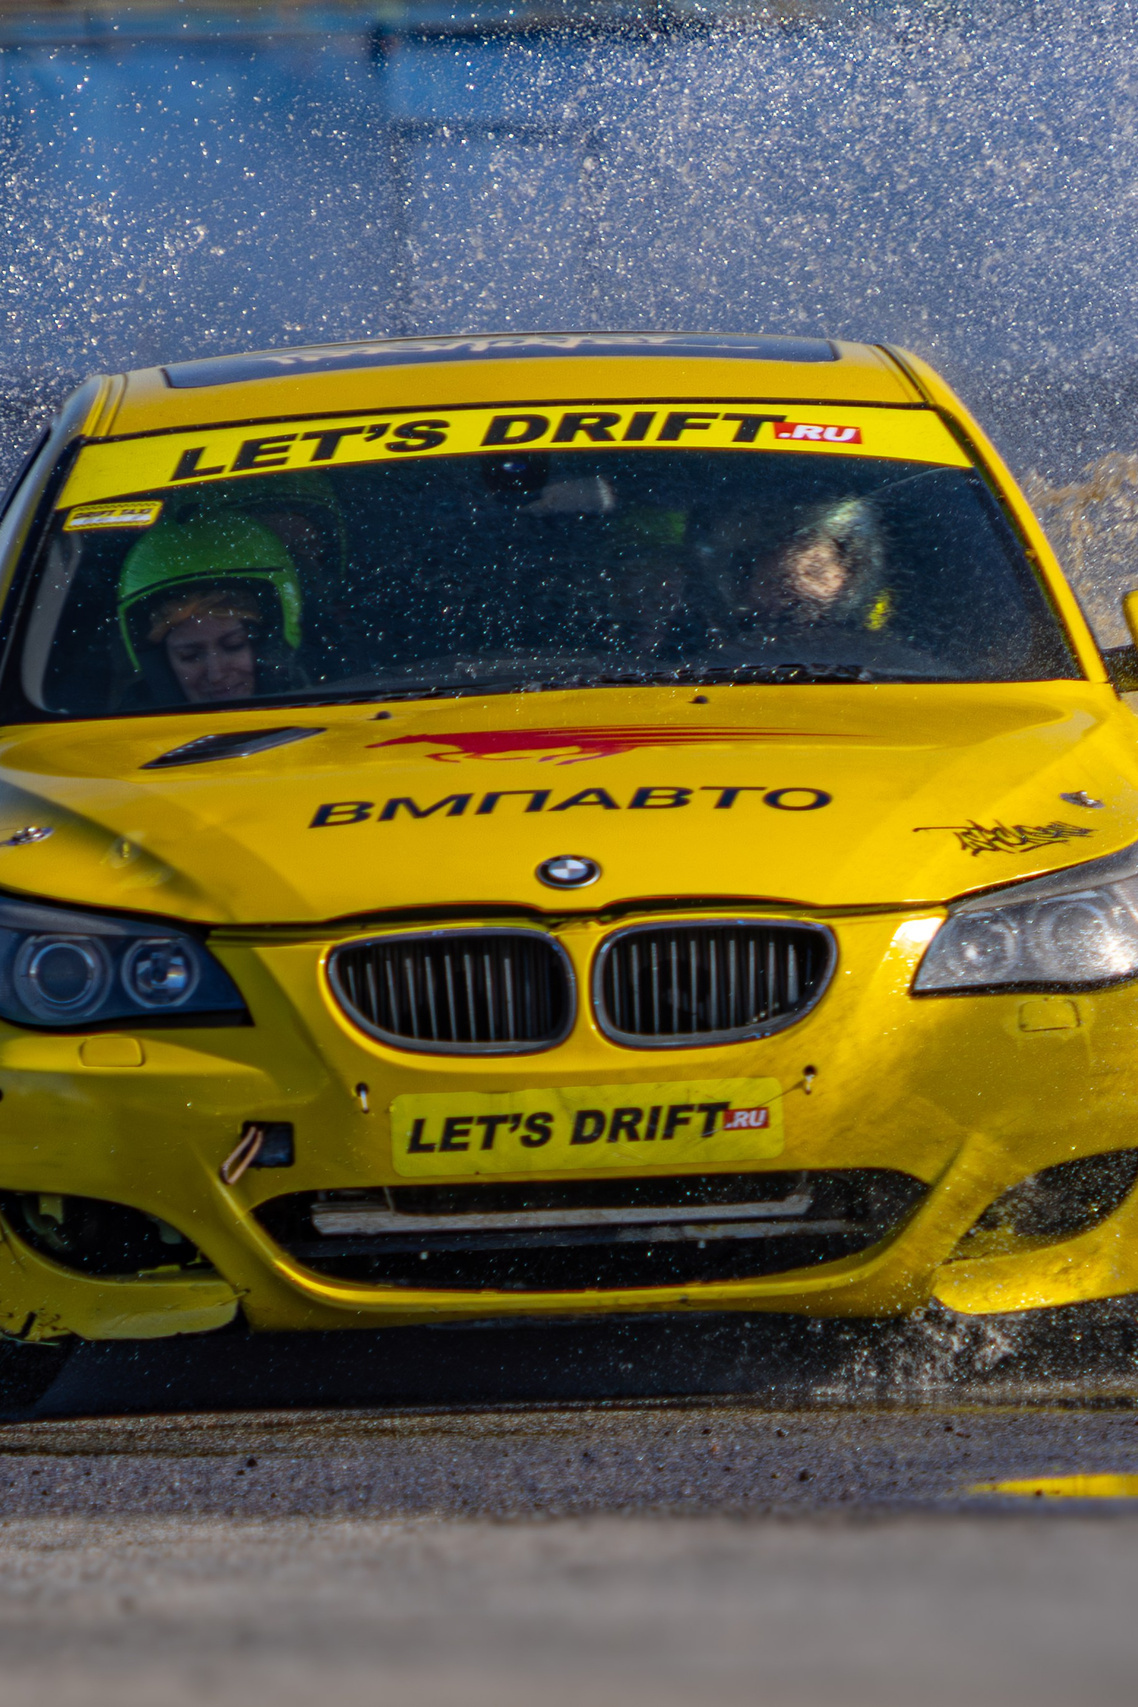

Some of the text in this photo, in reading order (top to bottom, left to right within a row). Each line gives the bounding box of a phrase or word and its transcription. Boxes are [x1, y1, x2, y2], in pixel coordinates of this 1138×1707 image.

[170, 419, 451, 482] LET'S
[308, 786, 833, 828] ВМПАВТО
[407, 1112, 554, 1154] LET'S
